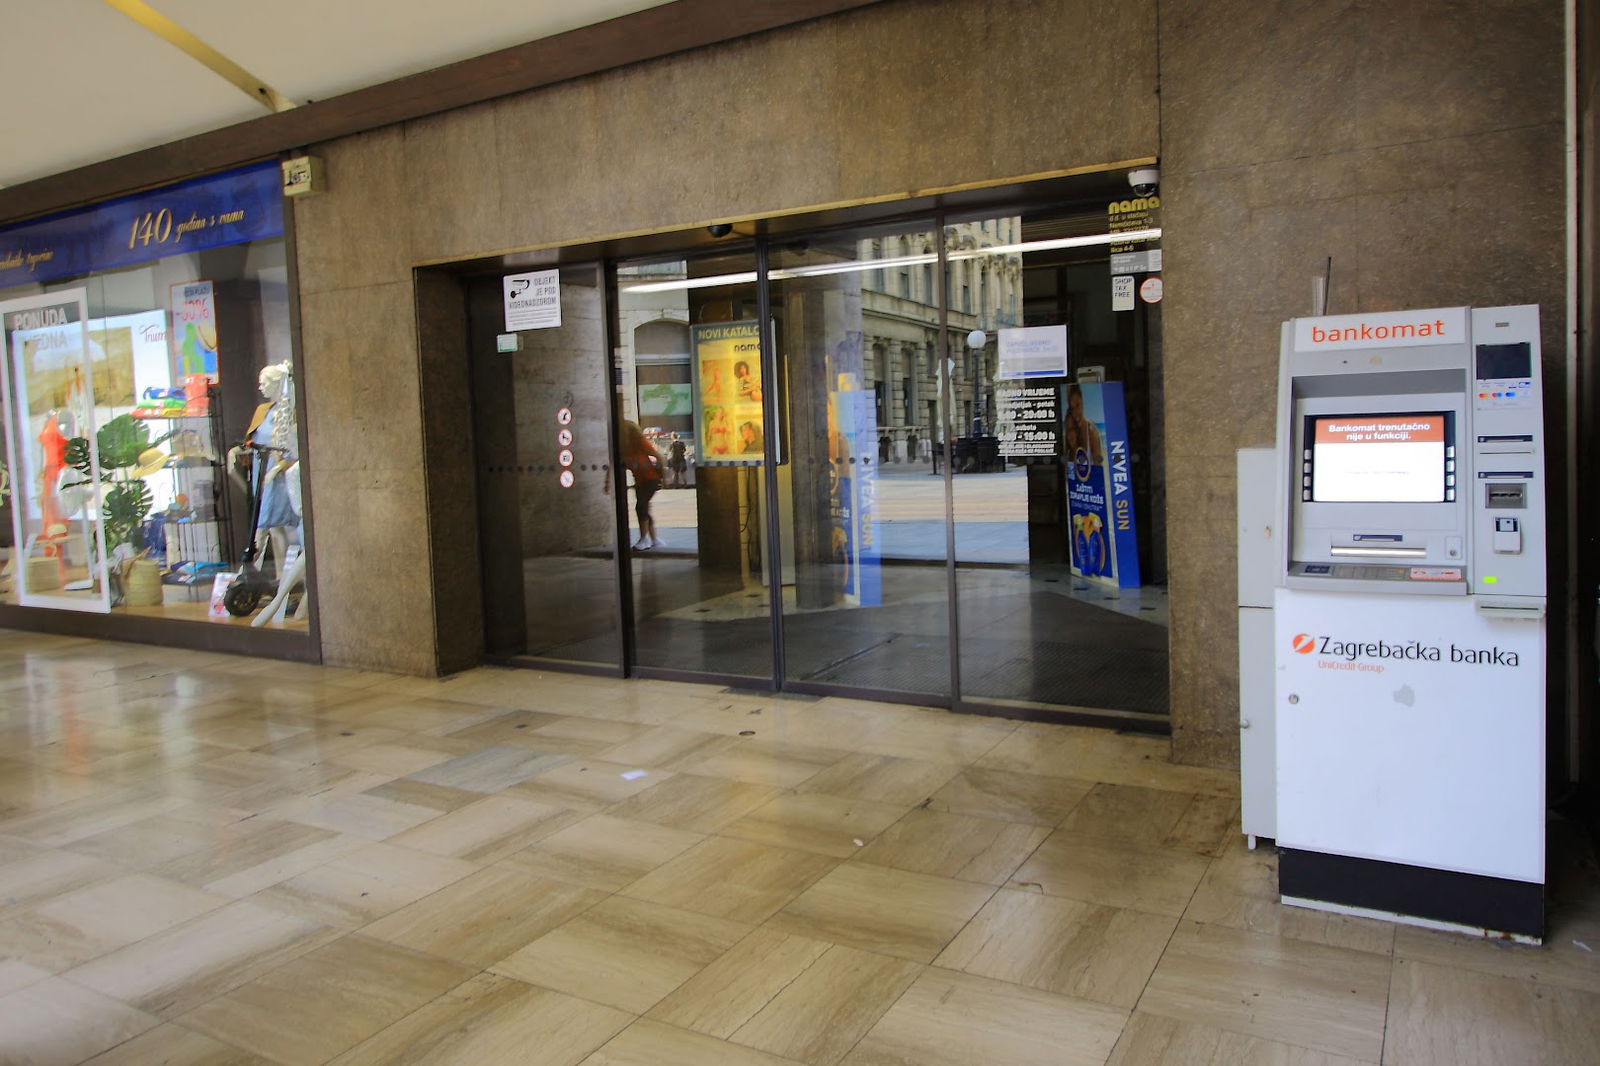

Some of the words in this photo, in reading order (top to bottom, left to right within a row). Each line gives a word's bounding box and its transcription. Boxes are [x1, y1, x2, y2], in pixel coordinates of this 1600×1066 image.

[1108, 196, 1160, 214] nama
[128, 208, 172, 249] 140
[534, 276, 555, 286] OBJEKT
[545, 286, 556, 295] POD
[15, 307, 68, 330] PONUDA
[698, 327, 721, 339] NOVI
[1312, 319, 1446, 343] bankomat
[1023, 387, 1055, 396] VRIJEME
[1328, 424, 1376, 433] Bankomat
[1378, 422, 1431, 431] trenutačno
[1346, 433, 1363, 441] nije
[1374, 432, 1411, 441] funkciji.
[1110, 441, 1129, 496] NIVEA
[1116, 500, 1130, 530] SUN
[1319, 636, 1441, 661] Zagrebačka
[1450, 644, 1519, 667] banka
[1318, 659, 1356, 671] UniCredit
[1358, 662, 1385, 674] Group
